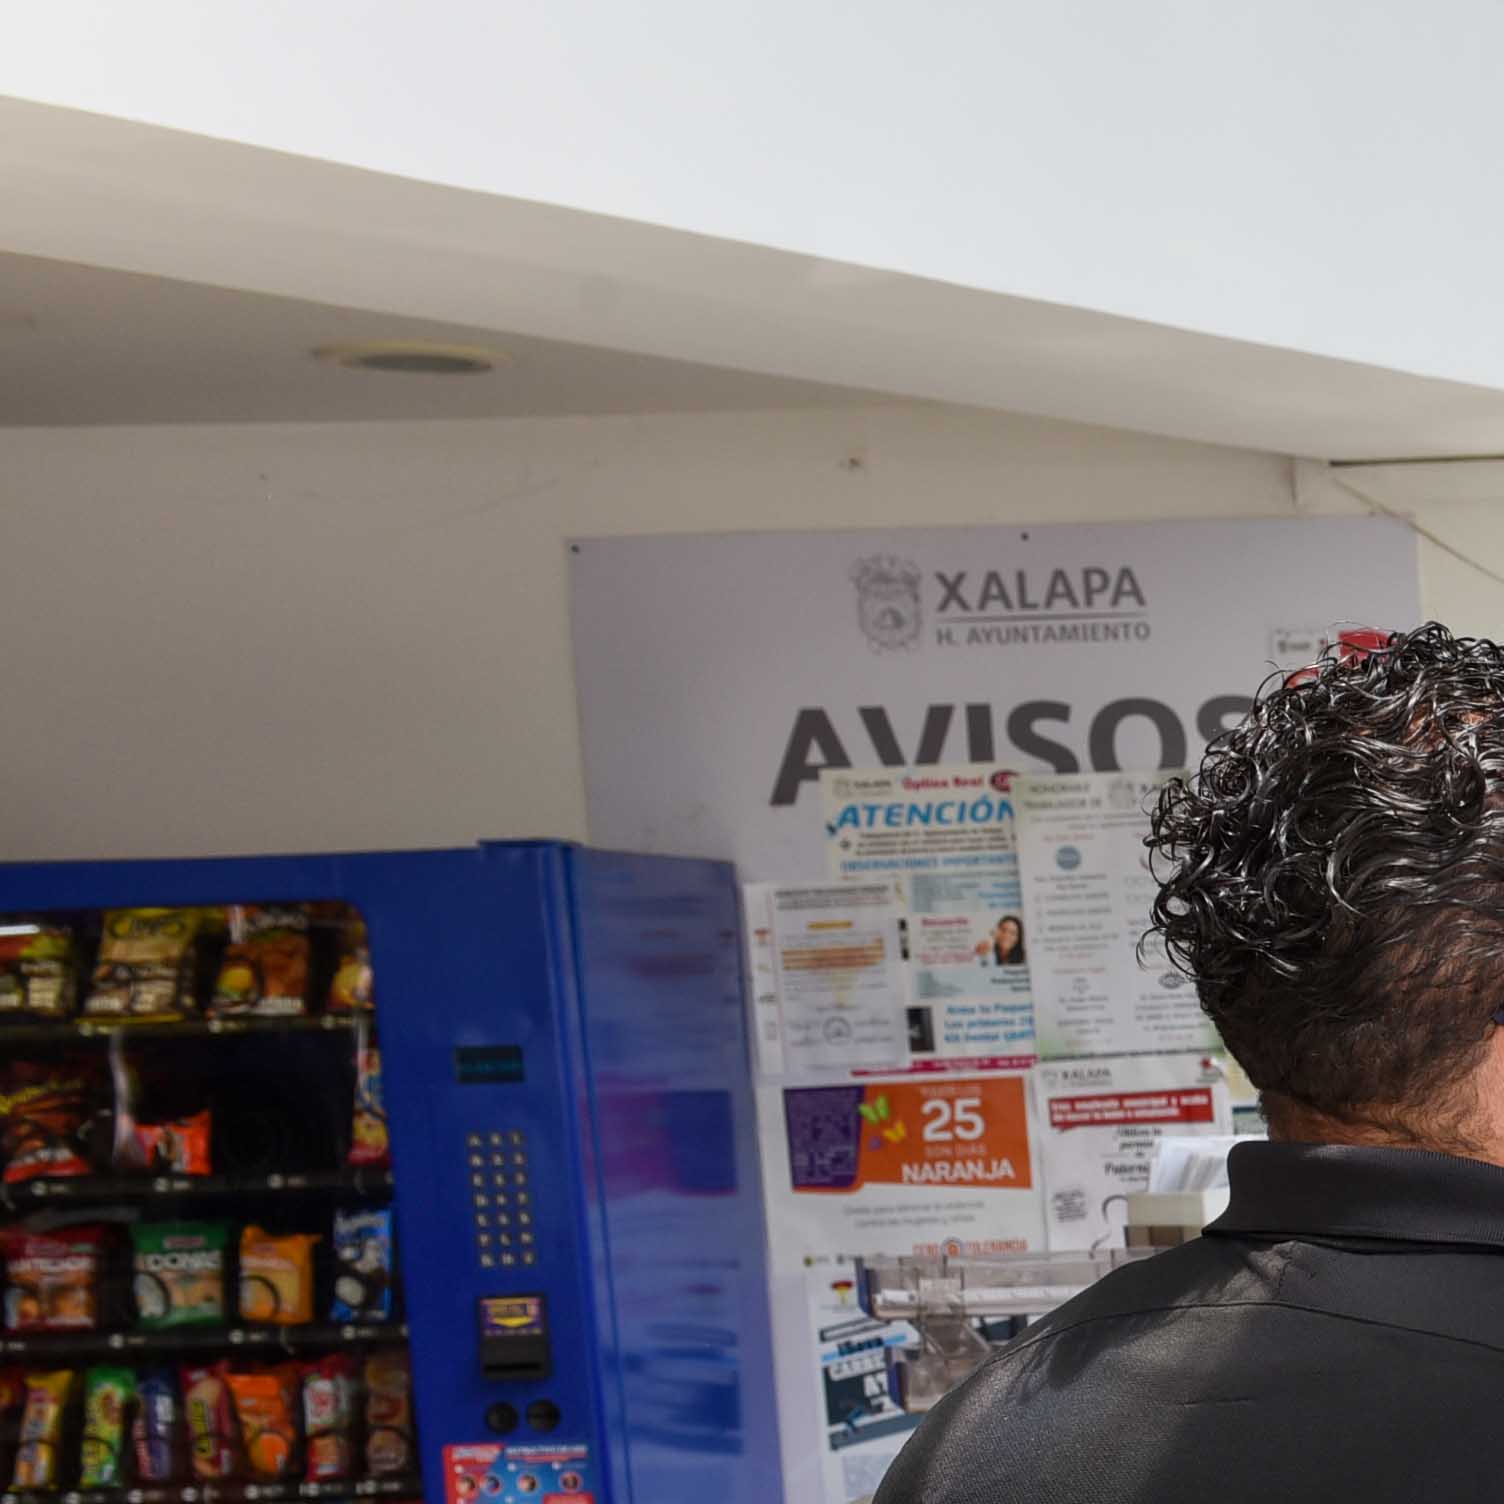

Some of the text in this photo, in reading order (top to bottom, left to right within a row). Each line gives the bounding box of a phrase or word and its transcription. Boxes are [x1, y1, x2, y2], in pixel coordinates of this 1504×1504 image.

[935, 565, 1145, 613] XALAPA
[937, 623, 1150, 646] H. AYUNTAMIENTO
[921, 1098, 984, 1141] 25
[901, 1158, 1014, 1183] NARANJA
